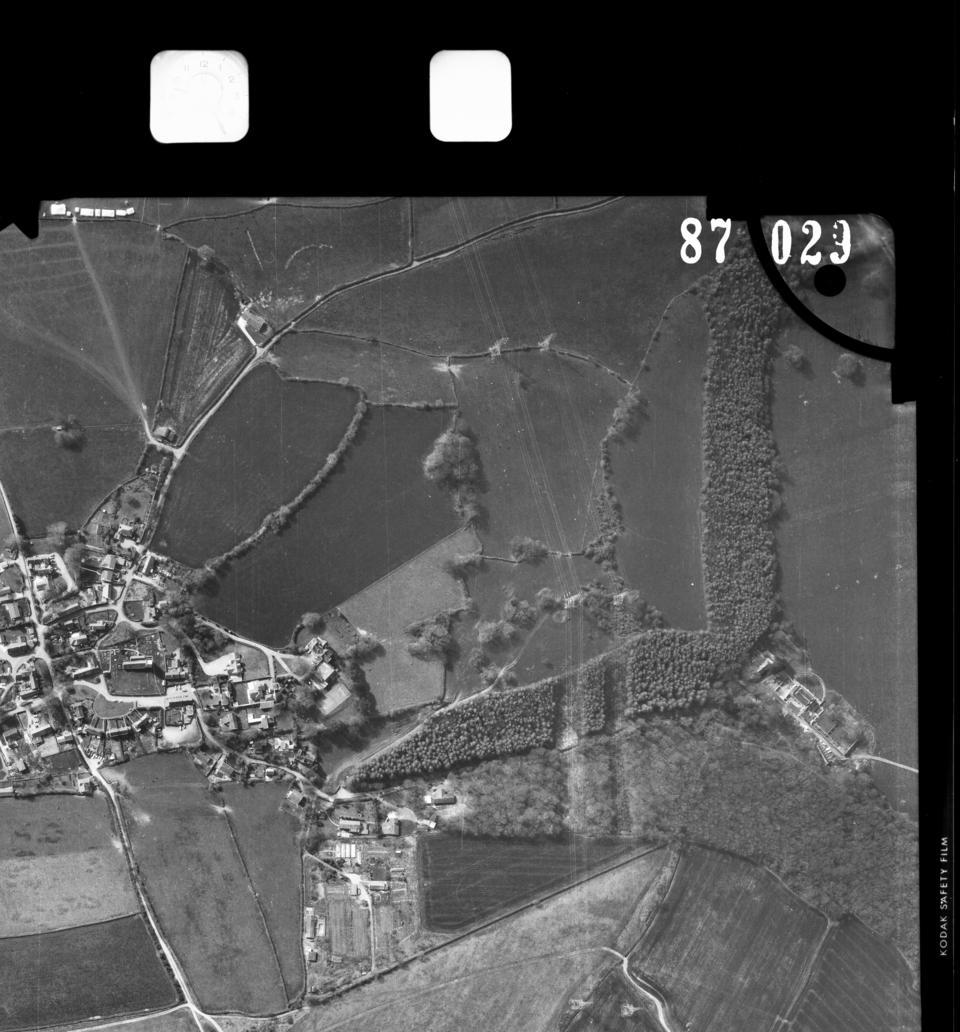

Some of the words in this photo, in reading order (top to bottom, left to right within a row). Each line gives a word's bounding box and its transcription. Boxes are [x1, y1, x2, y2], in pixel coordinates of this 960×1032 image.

[680, 217, 731, 264] 87
[939, 836, 948, 862] FILM
[939, 868, 948, 910] SAFETY
[939, 915, 948, 956] KODAK
